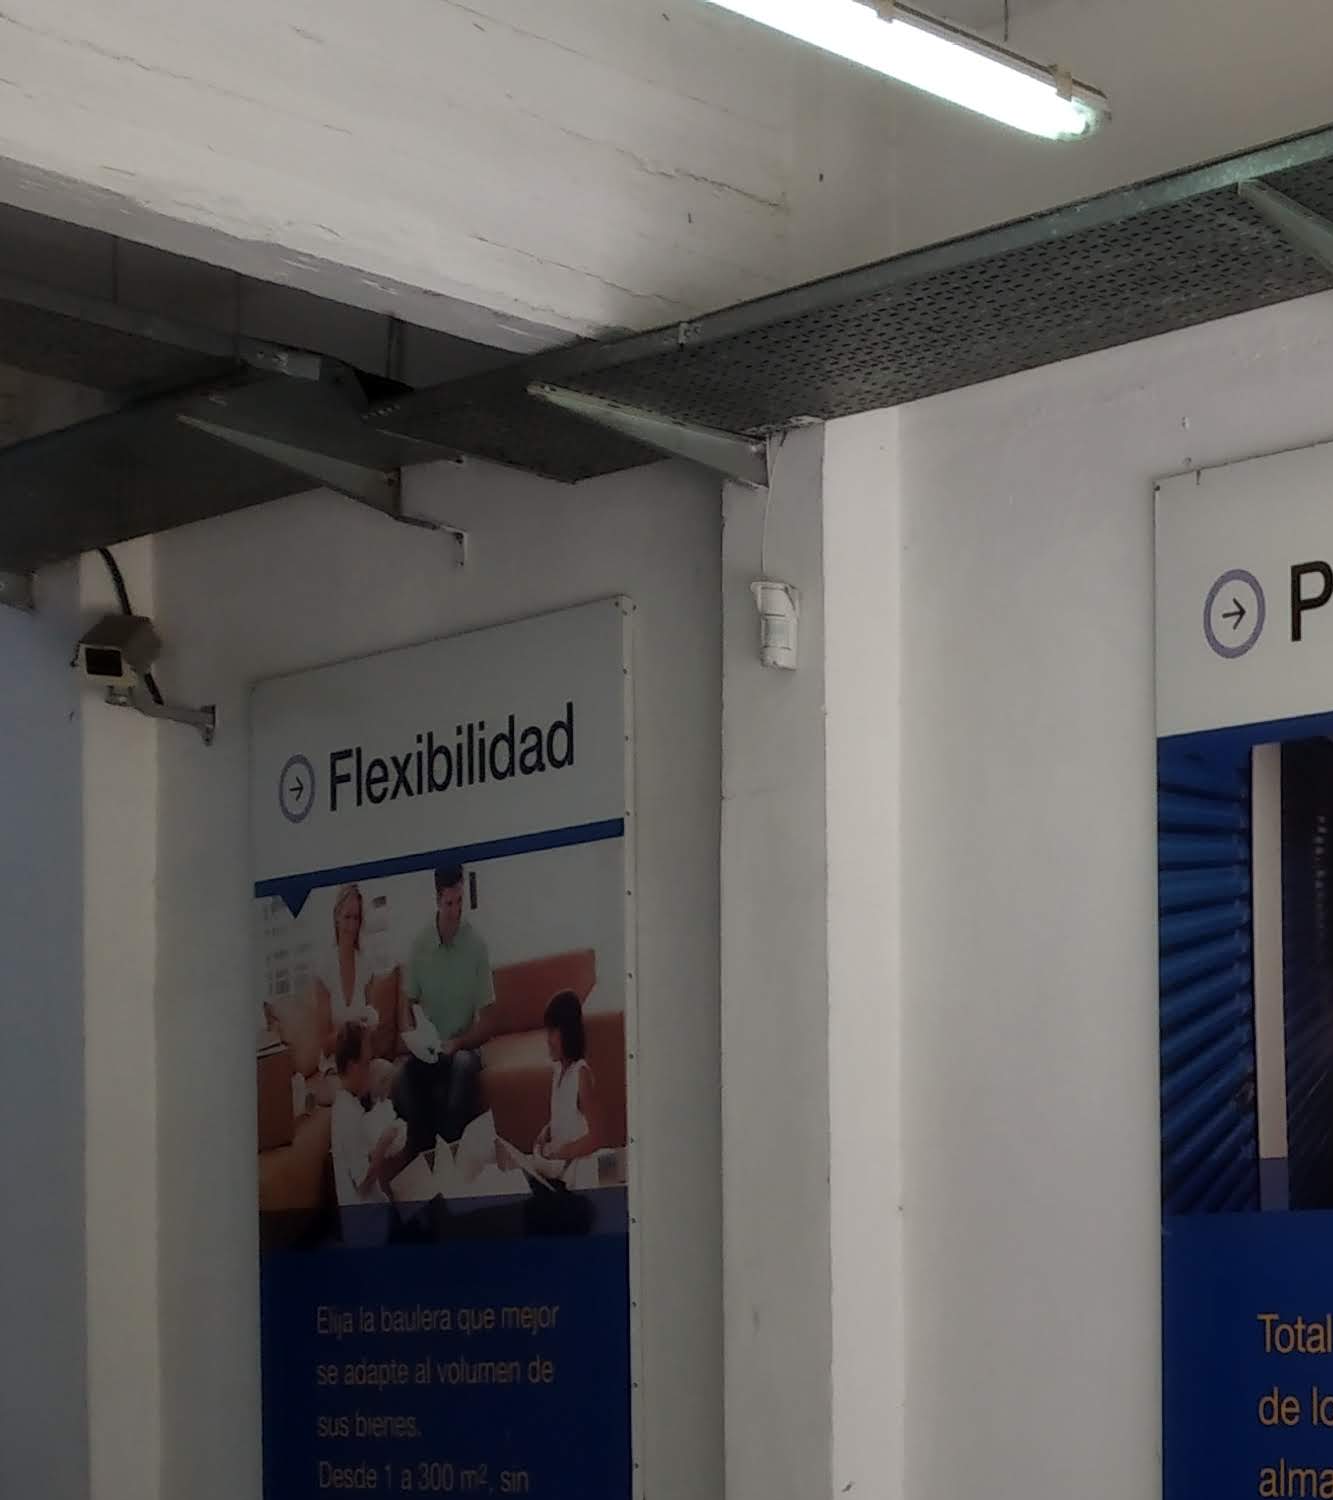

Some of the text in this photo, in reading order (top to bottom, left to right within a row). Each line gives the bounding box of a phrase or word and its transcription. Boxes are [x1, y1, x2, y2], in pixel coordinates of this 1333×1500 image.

[329, 701, 575, 812] Flexibilidad
[316, 1303, 560, 1343] Elija la baulera que mejor
[1257, 1313, 1333, 1355] Total
[315, 1353, 553, 1390] se adapte al volumen de
[1258, 1386, 1299, 1425] de
[316, 1411, 423, 1440] sus bienes.
[318, 1460, 377, 1488] Desde
[384, 1463, 392, 1489] 1
[400, 1469, 413, 1490] a
[416, 1461, 454, 1490] 300
[499, 1467, 528, 1493] sin
